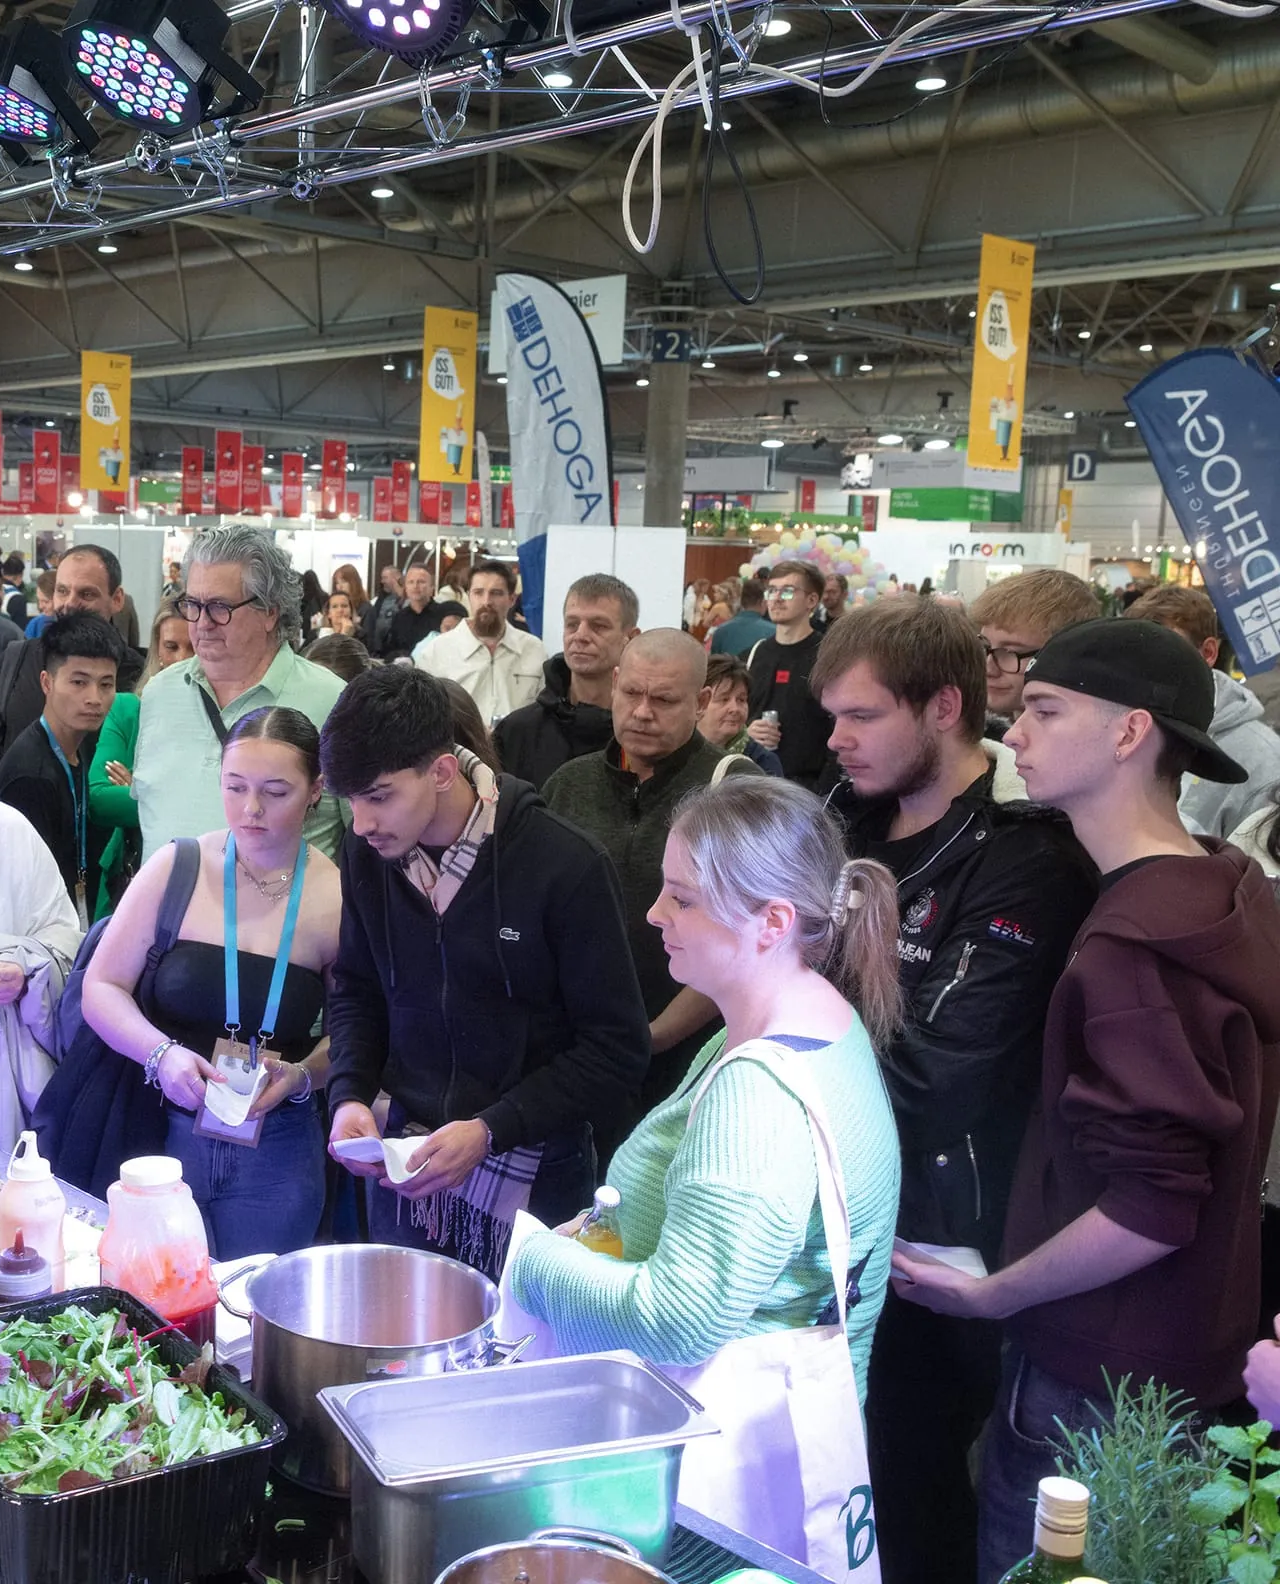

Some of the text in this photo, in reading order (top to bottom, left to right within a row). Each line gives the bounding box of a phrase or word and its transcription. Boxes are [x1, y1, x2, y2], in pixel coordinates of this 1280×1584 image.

[665, 332, 680, 359] 2
[521, 335, 603, 523] DEHOGA
[1073, 453, 1091, 479] D
